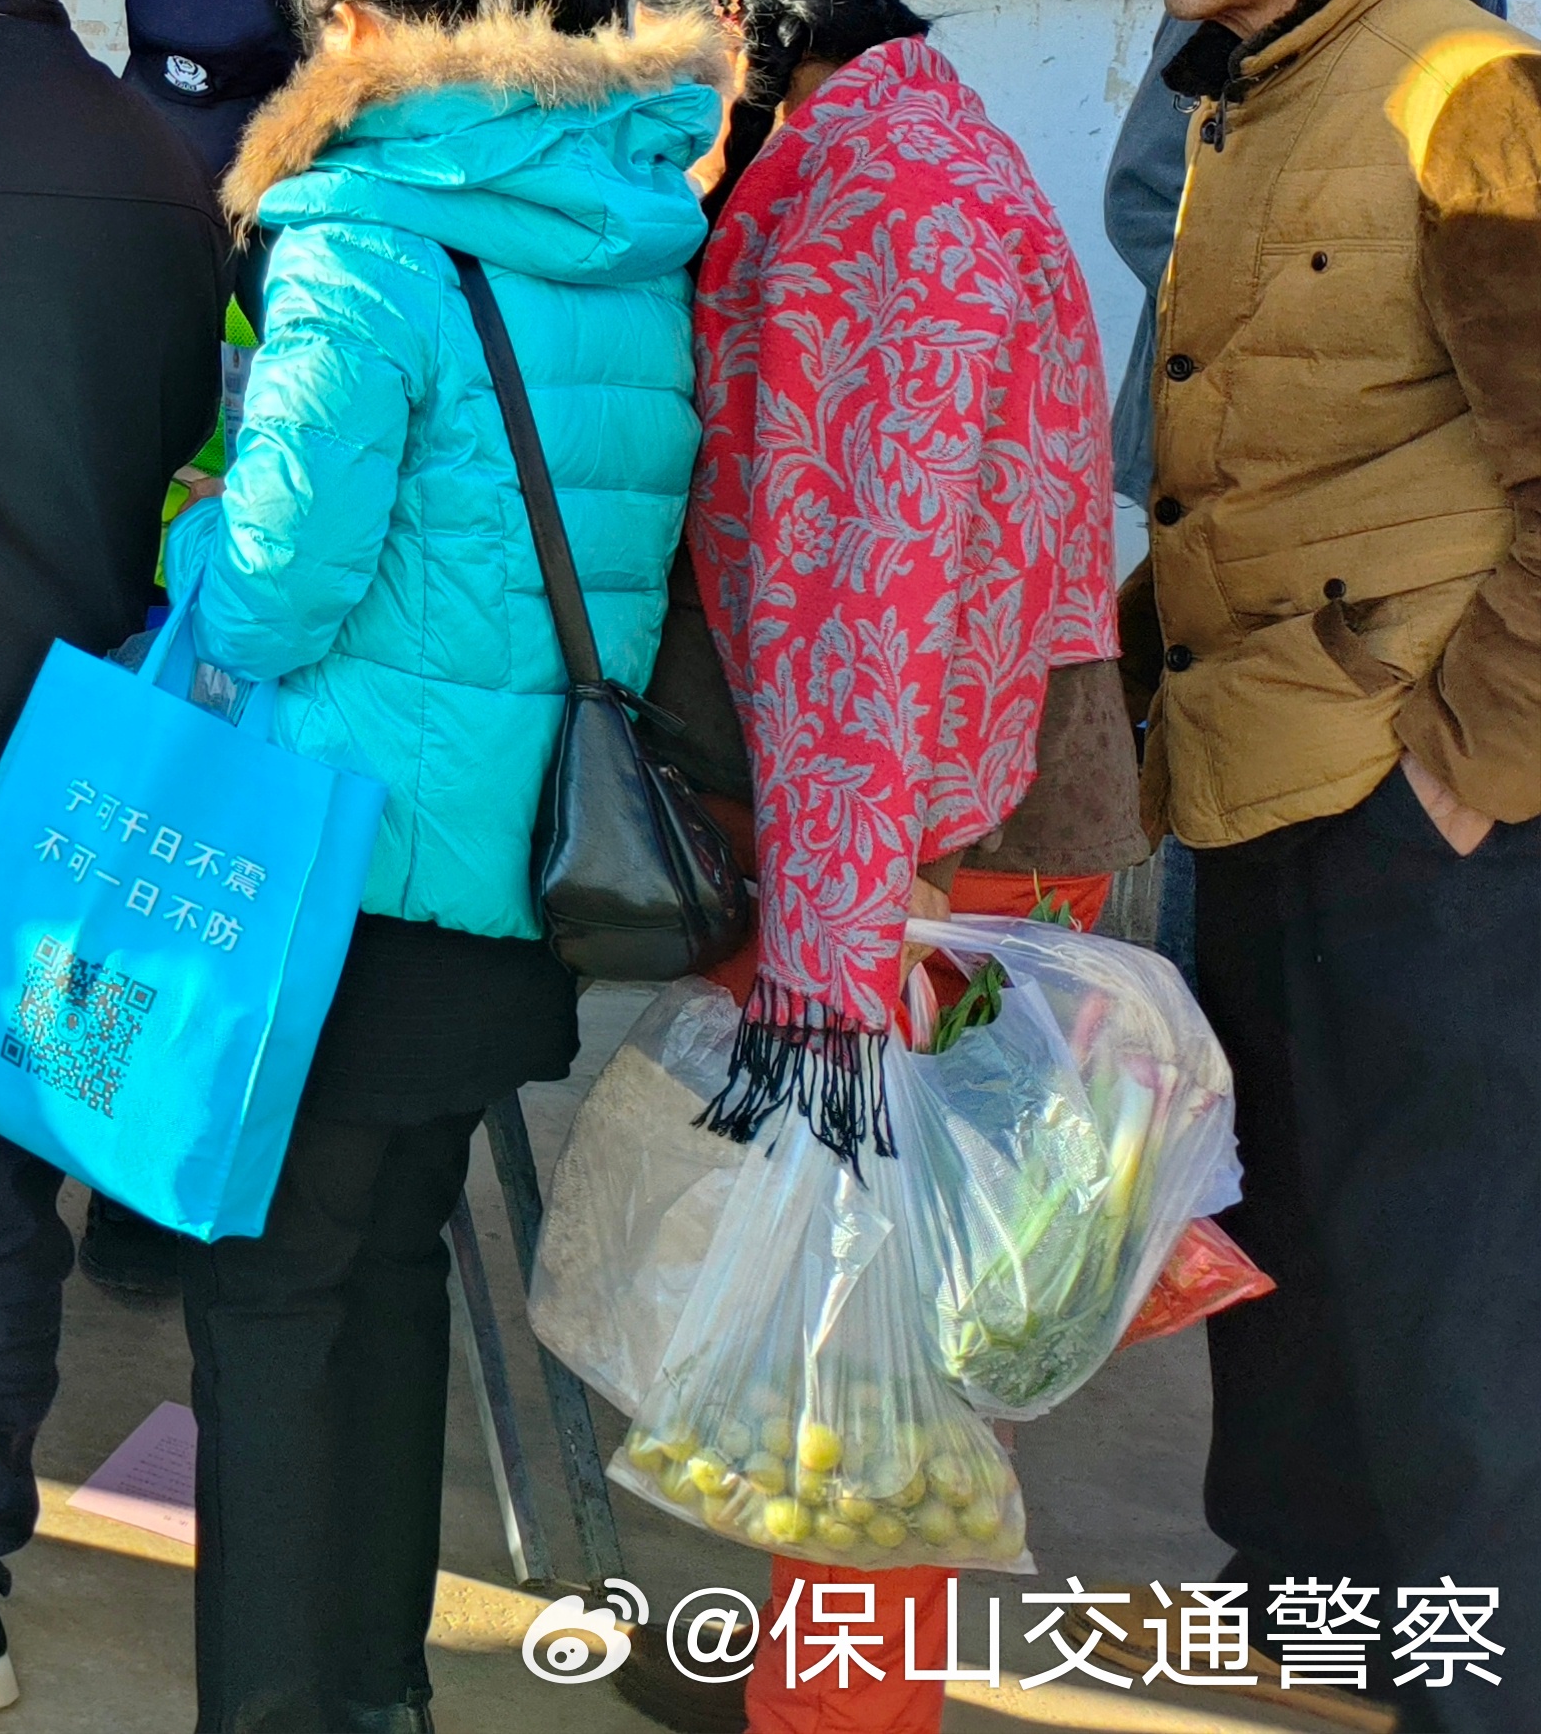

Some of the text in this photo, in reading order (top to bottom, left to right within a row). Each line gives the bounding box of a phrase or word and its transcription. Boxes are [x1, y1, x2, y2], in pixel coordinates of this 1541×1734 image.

[32, 826, 246, 952] 不可一日不防
[64, 777, 269, 902] 宁可千日不震
